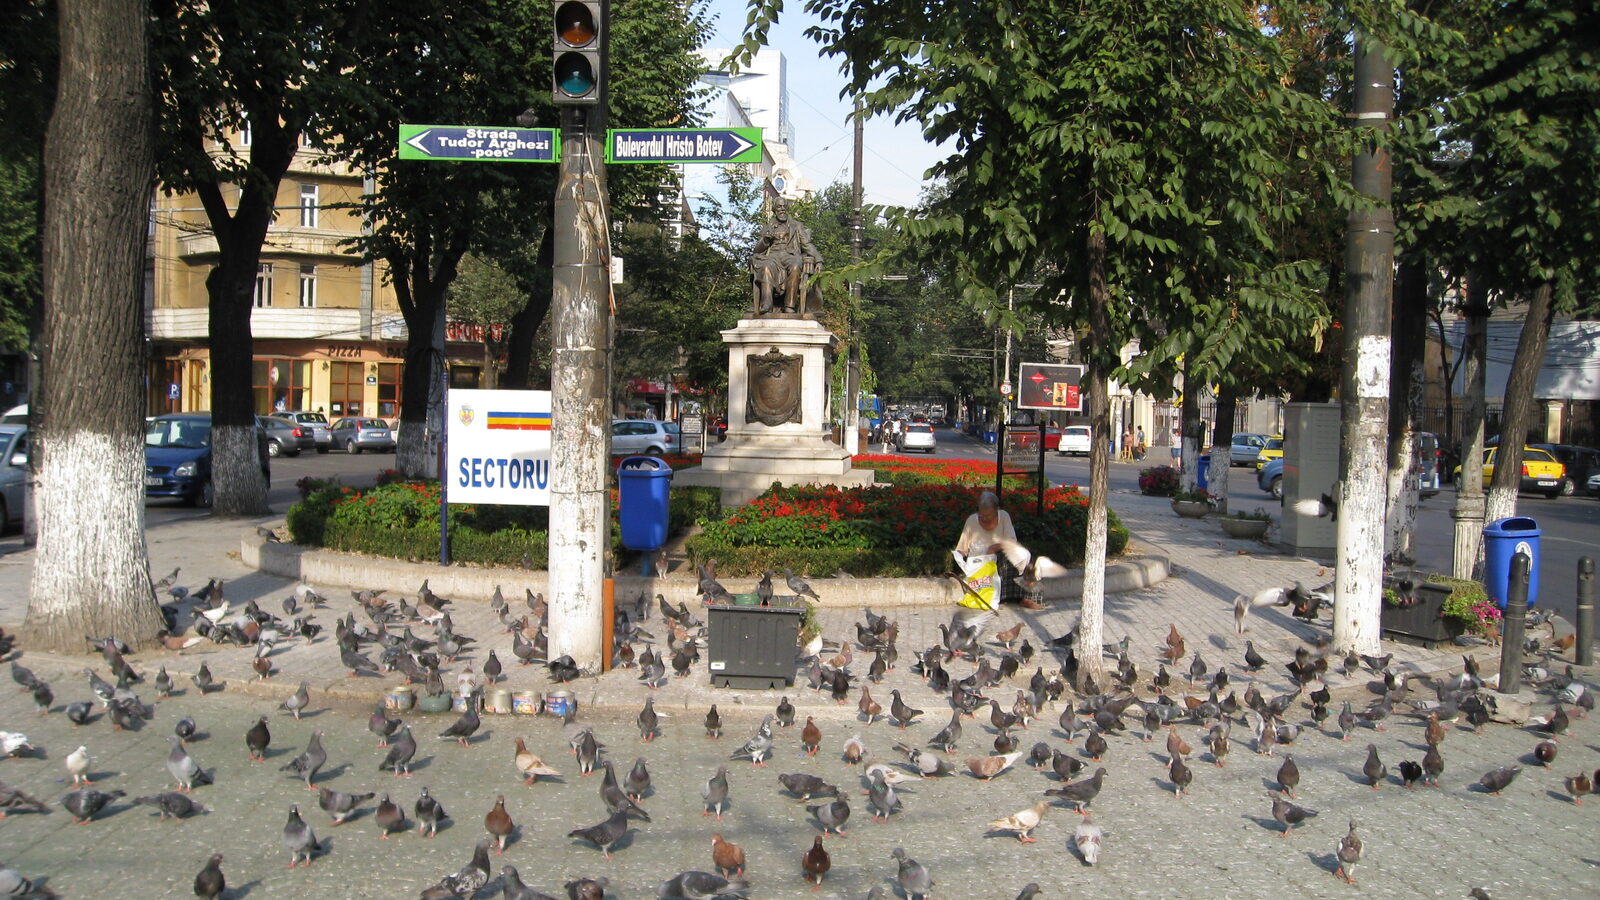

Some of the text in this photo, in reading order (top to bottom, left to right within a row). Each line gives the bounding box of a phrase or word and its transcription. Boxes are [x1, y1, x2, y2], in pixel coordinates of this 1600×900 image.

[466, 129, 518, 139] Strada
[438, 136, 549, 150] Tudor Arghezi
[616, 135, 724, 158] Bulevardul Hristo Botev
[470, 149, 514, 158] -poet-
[328, 345, 362, 358] PIZZA
[459, 457, 549, 490] SECTORU
